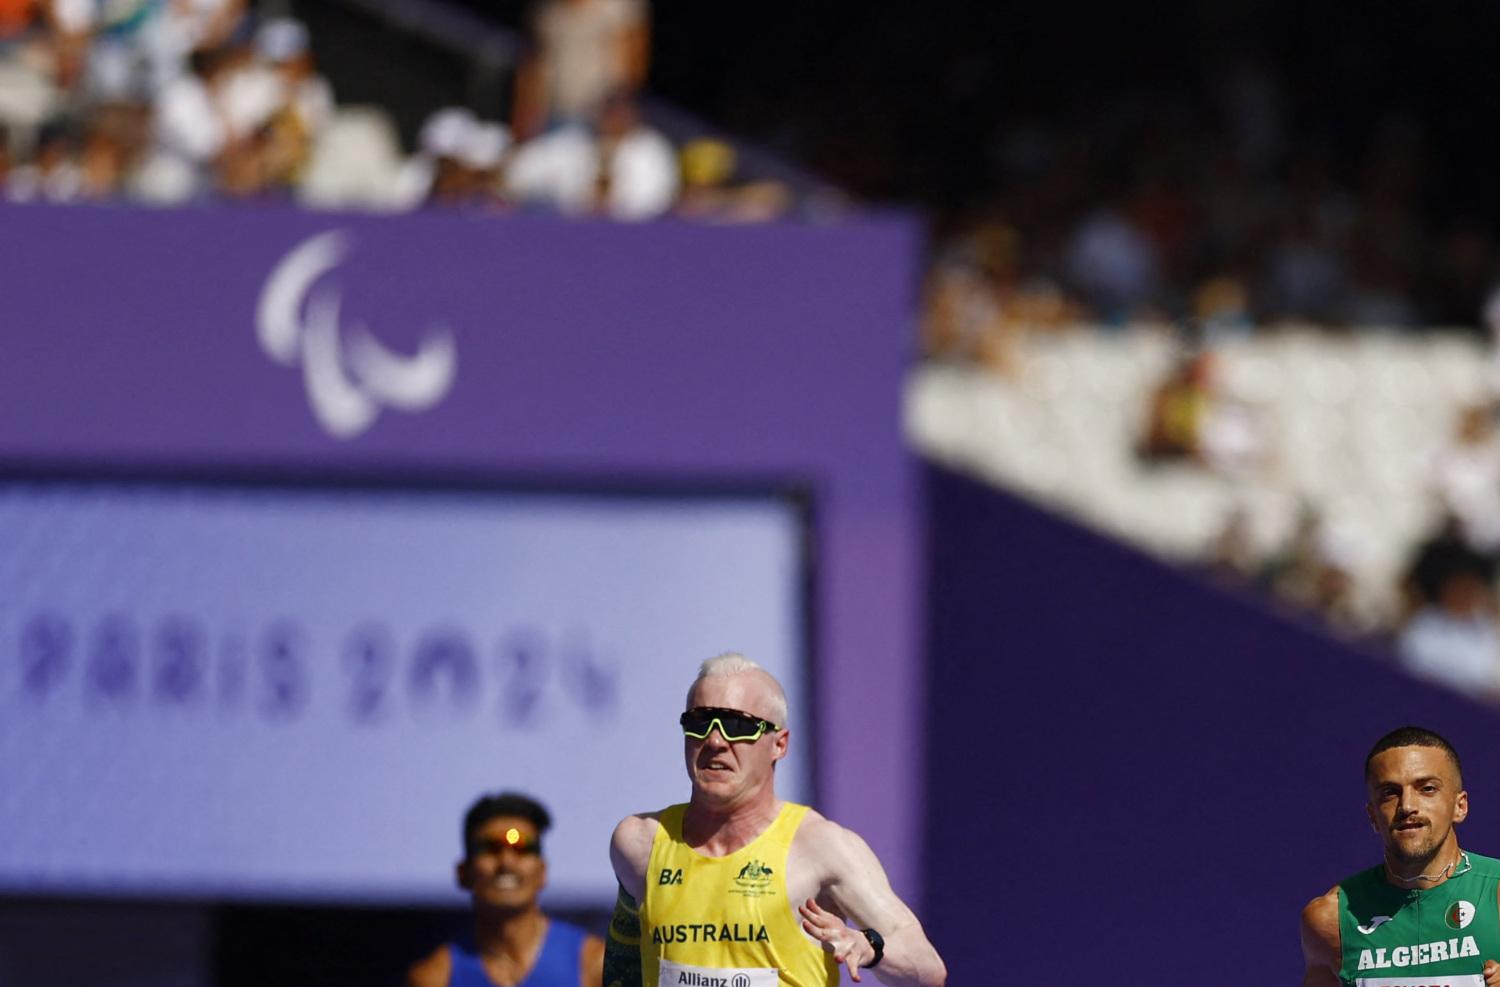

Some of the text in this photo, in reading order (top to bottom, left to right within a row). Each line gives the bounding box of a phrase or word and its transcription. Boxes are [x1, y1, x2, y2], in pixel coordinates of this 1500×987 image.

[338, 614, 622, 734] 2024
[652, 923, 770, 945] AUSTRALIA
[1357, 935, 1481, 971] ALGERIA
